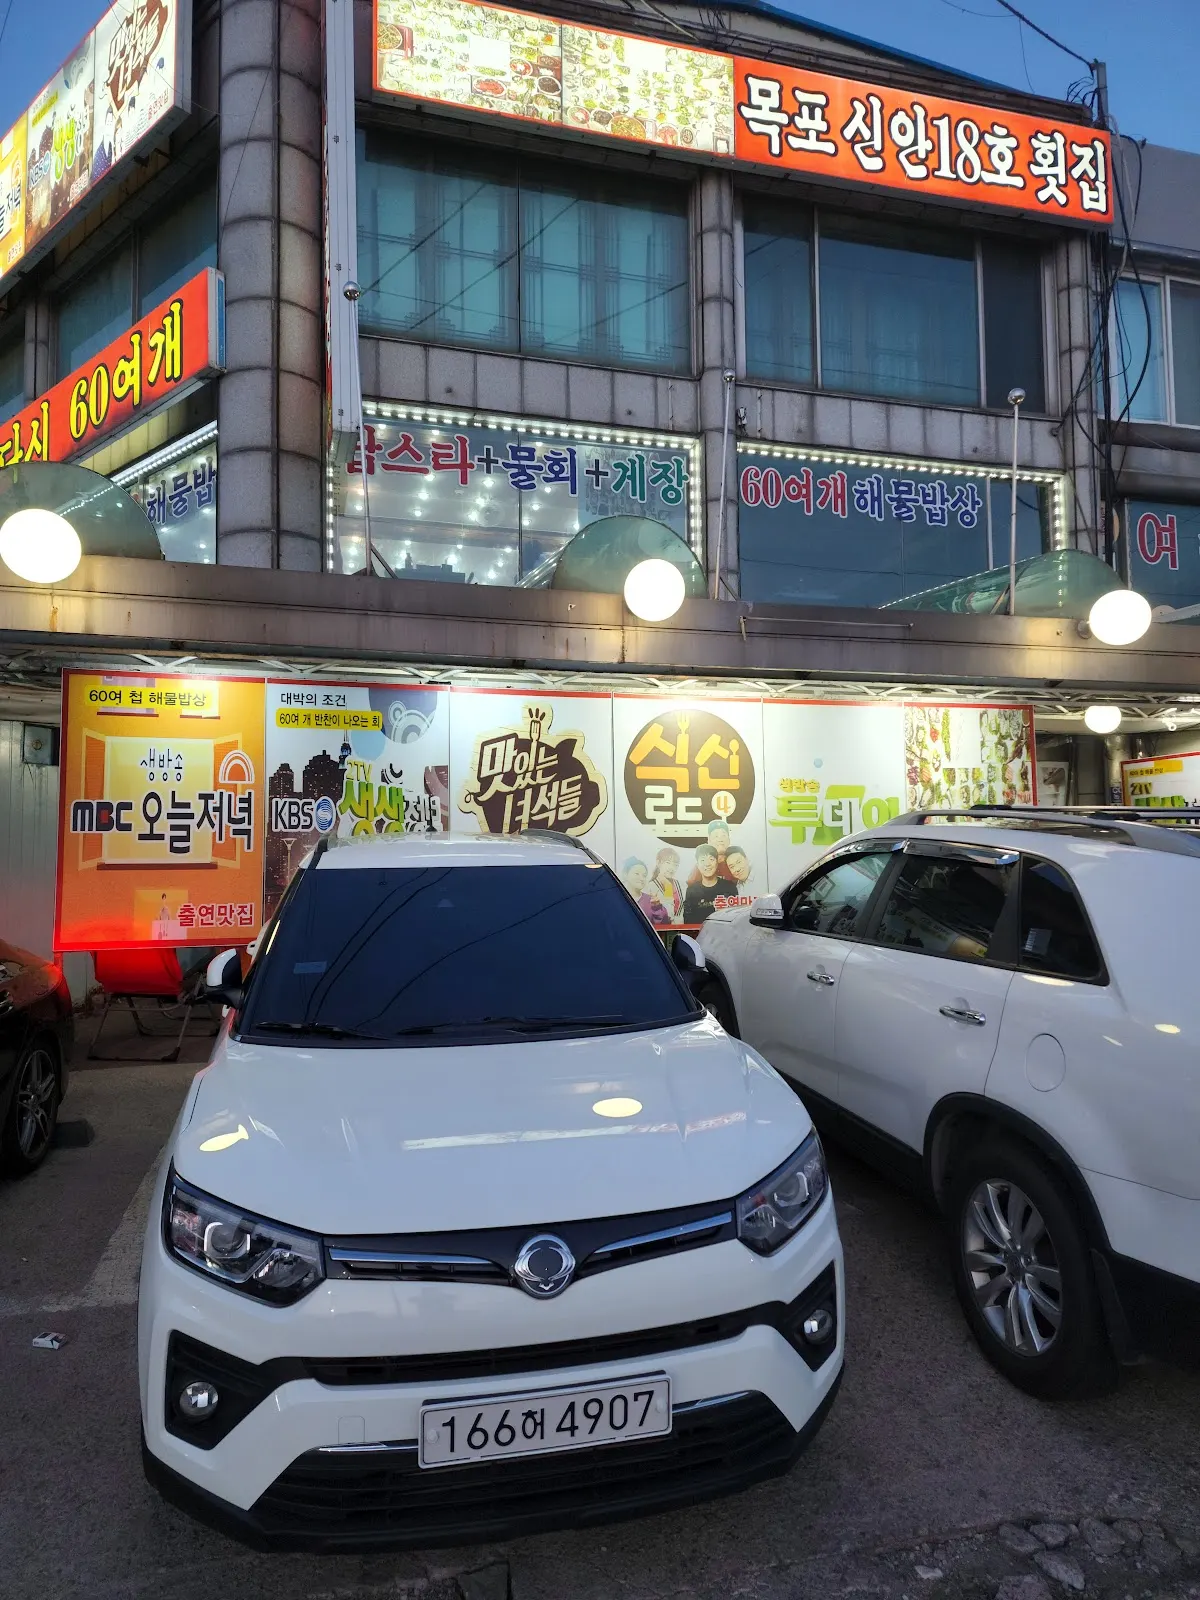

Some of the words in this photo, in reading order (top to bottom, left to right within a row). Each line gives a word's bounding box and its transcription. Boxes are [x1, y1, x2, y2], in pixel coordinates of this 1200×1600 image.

[739, 74, 837, 156] 목포
[841, 94, 1024, 189] 신안18호
[1028, 131, 1108, 213] 횟집
[69, 299, 183, 442] 60여개
[502, 443, 578, 497] 물회
[611, 452, 690, 505] 게장
[740, 466, 848, 518] 60여개
[853, 474, 982, 529] 해물밥상
[88, 689, 122, 705] 60여
[128, 690, 143, 705] 첩
[148, 691, 207, 707] 해물밥상
[279, 712, 299, 726] 60여
[302, 713, 311, 727] 개
[315, 713, 340, 727] 반찬이
[343, 714, 369, 728] 나오는
[371, 715, 380, 728] 회
[280, 692, 317, 706] 대박의
[321, 693, 346, 707] 조건
[140, 748, 183, 782] 생방송
[346, 760, 372, 782] 2TV
[477, 736, 559, 802] 맛있는
[628, 720, 740, 793] 식신
[137, 790, 253, 854] 오늘저녁
[274, 800, 314, 831] KBS
[502, 774, 582, 834] 녀석들
[644, 785, 703, 825] 로드
[768, 784, 900, 846] 투데이
[177, 902, 254, 928] 출연맛집
[441, 1407, 545, 1453] 166허
[555, 1389, 655, 1437] 4907
